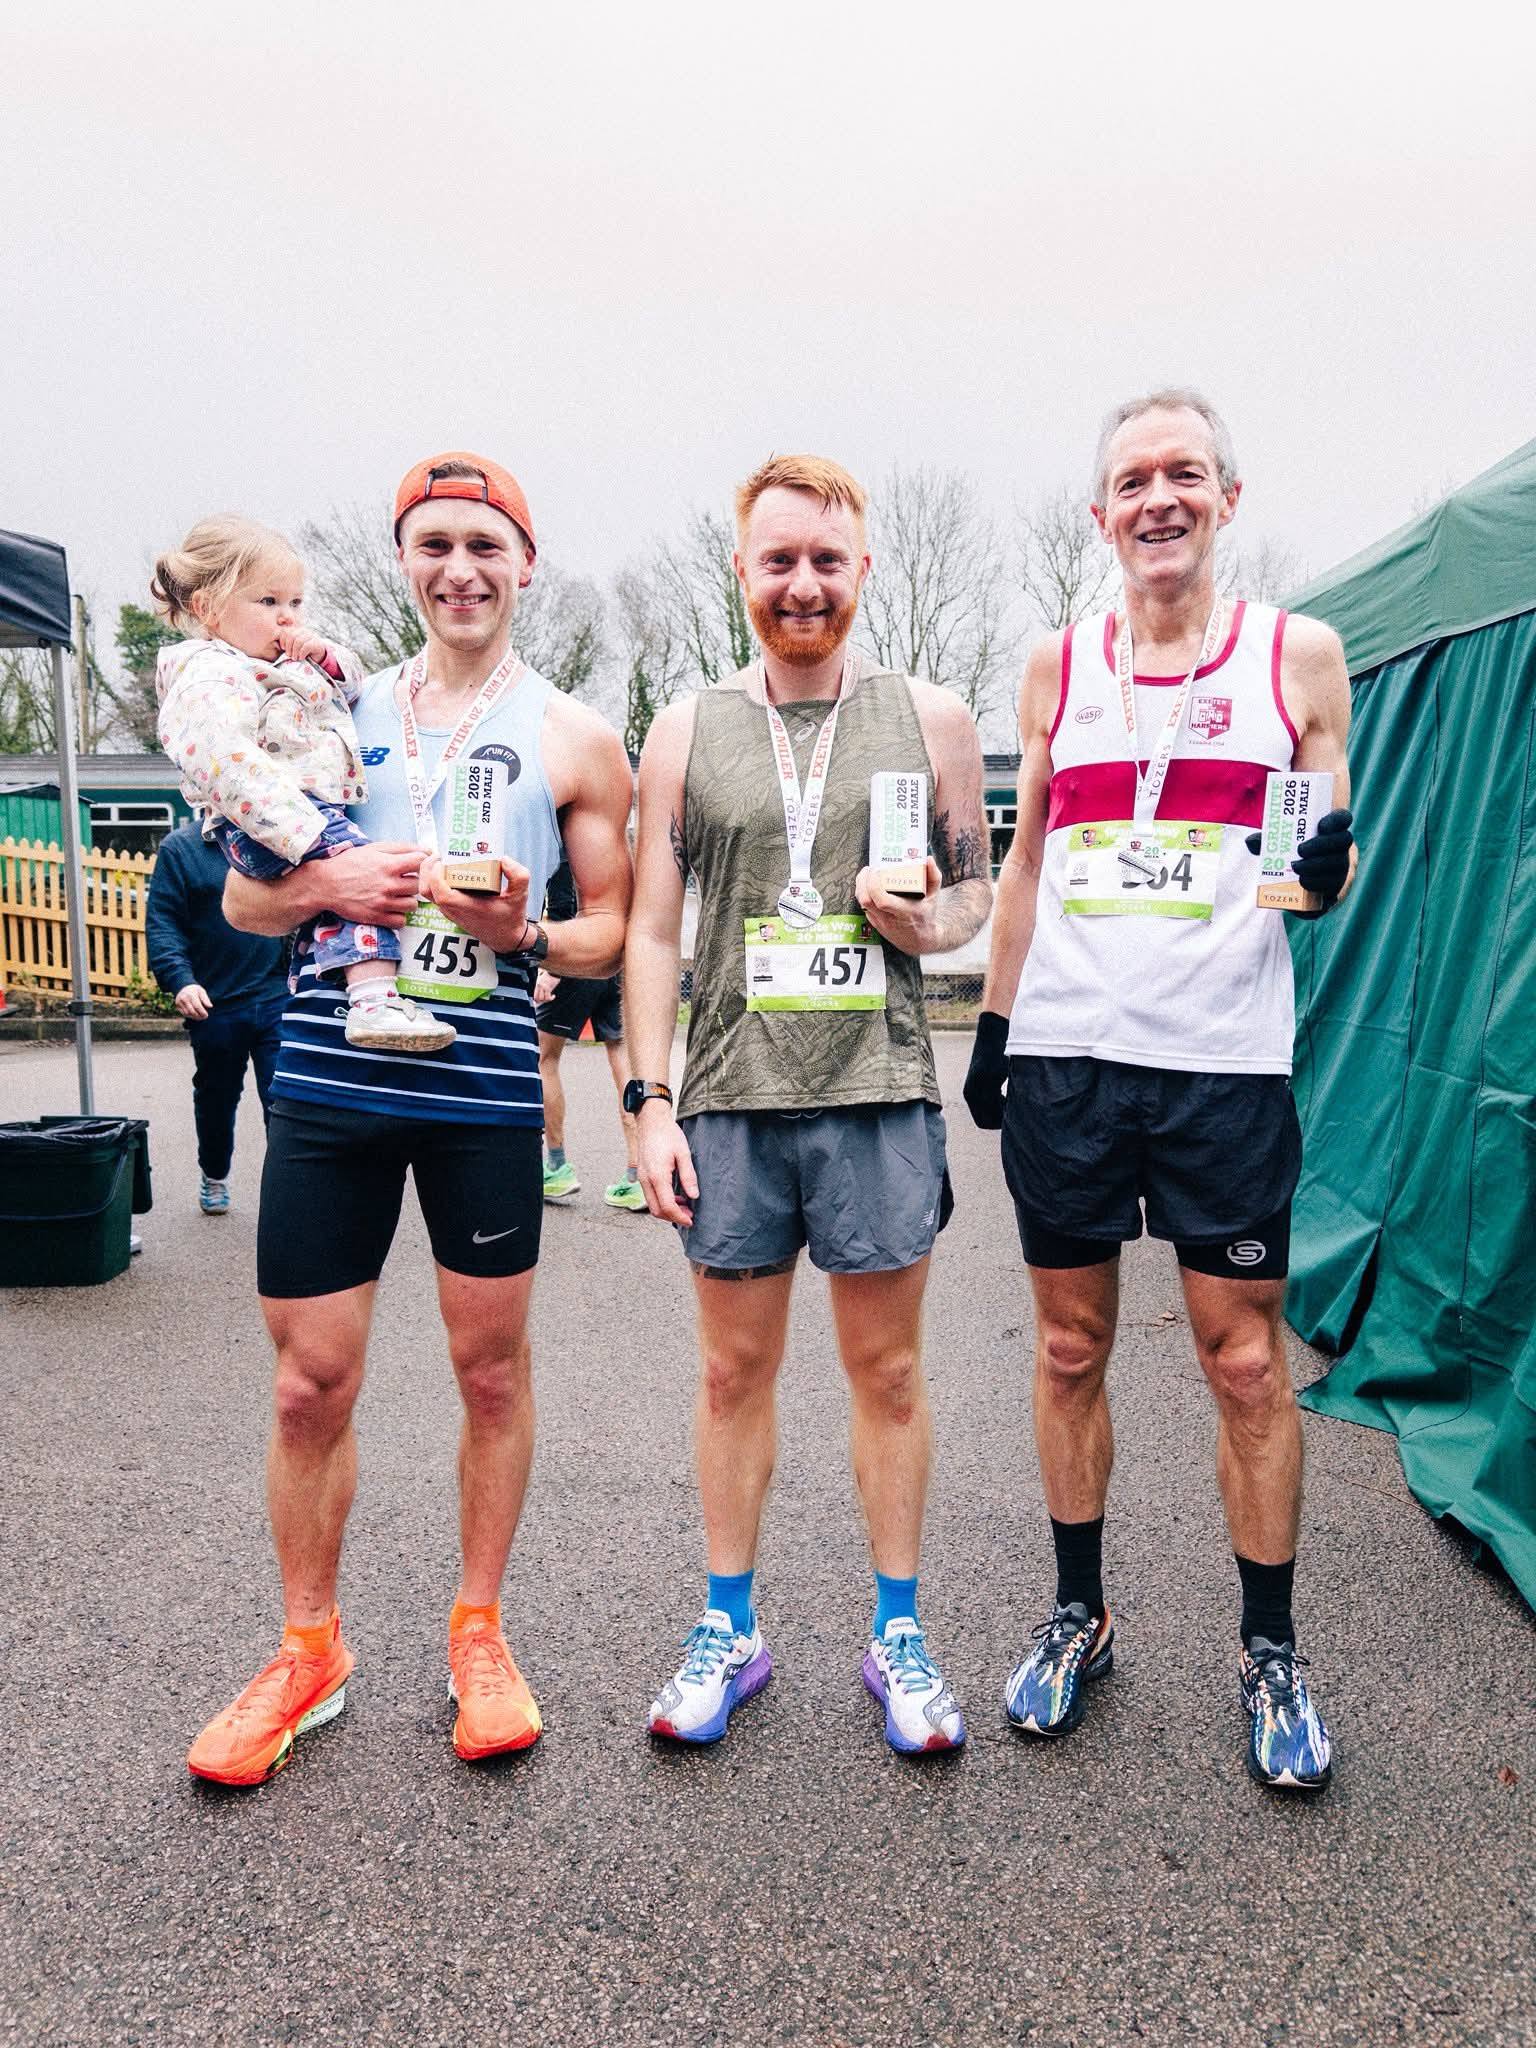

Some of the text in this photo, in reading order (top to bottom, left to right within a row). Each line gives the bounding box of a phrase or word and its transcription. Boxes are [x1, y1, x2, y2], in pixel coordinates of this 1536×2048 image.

[1078, 710, 1101, 721] wasp
[1120, 681, 1134, 733] EXETER
[402, 713, 418, 759] MILER
[503, 750, 516, 761] FIT
[776, 735, 794, 780] MILER
[897, 779, 907, 809] 2026
[1150, 744, 1173, 798] TOZERS
[466, 766, 480, 835] WAY 2026
[482, 767, 493, 823] 2ND MALE
[911, 779, 919, 828] 1ST MALE
[1267, 781, 1281, 853] GRANITE
[1280, 780, 1297, 853] WAY 2026
[1297, 780, 1309, 841] 3RD MALE
[803, 794, 820, 844] TOZERS
[448, 838, 470, 851] 20
[1263, 858, 1285, 871] 20
[1265, 895, 1299, 903] TOZERS
[413, 933, 480, 977] 455
[808, 947, 867, 985] 457
